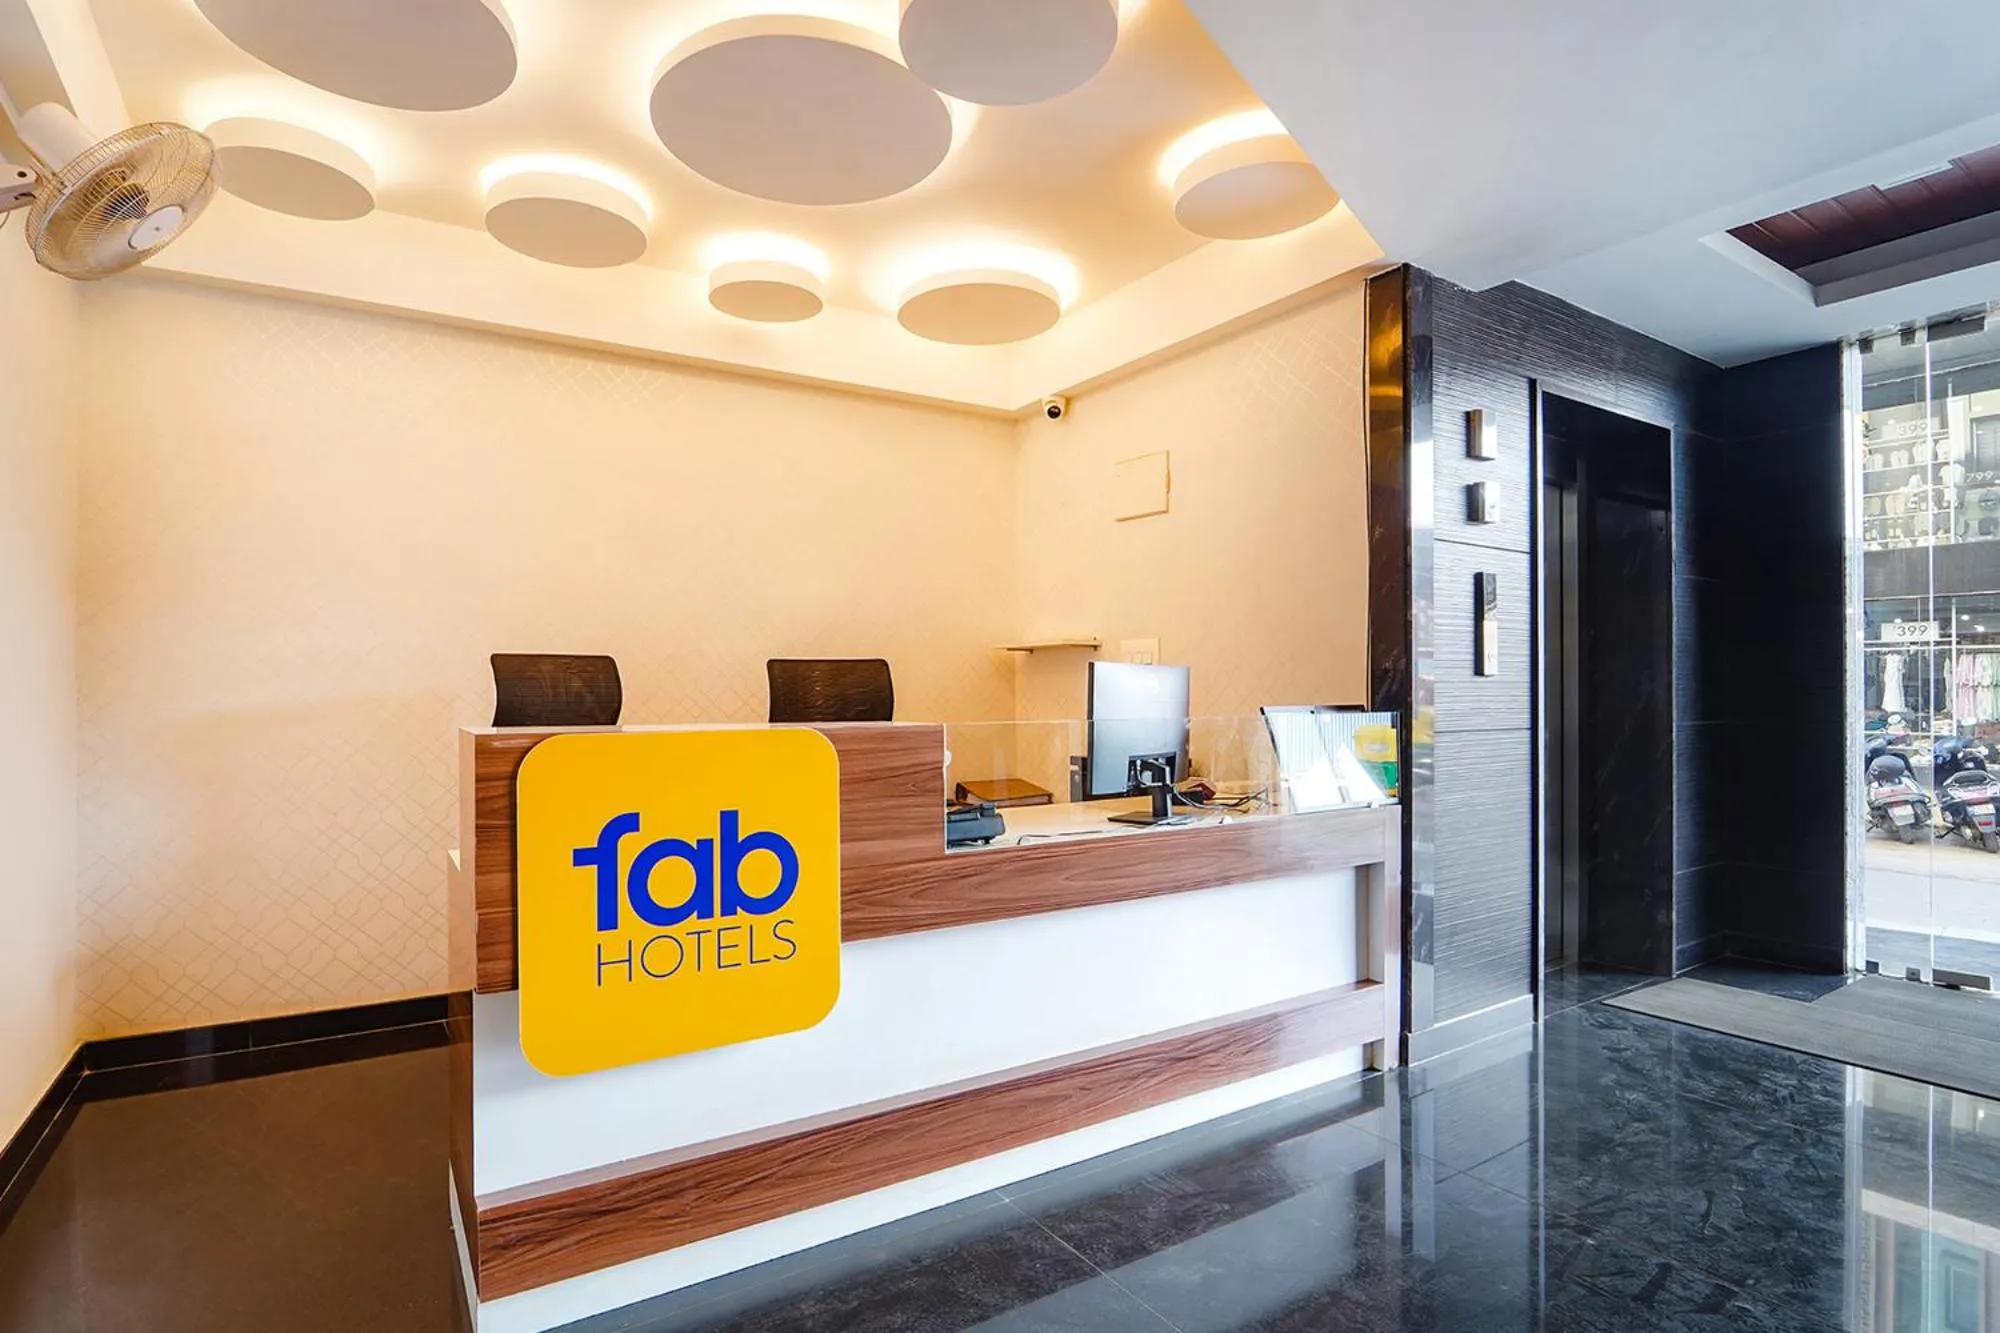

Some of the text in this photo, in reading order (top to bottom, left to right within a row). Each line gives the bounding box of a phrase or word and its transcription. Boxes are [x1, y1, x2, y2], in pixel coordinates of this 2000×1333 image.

[1896, 623, 1929, 638] 399
[572, 809, 800, 932] fab
[596, 918, 797, 987] HOTELS
